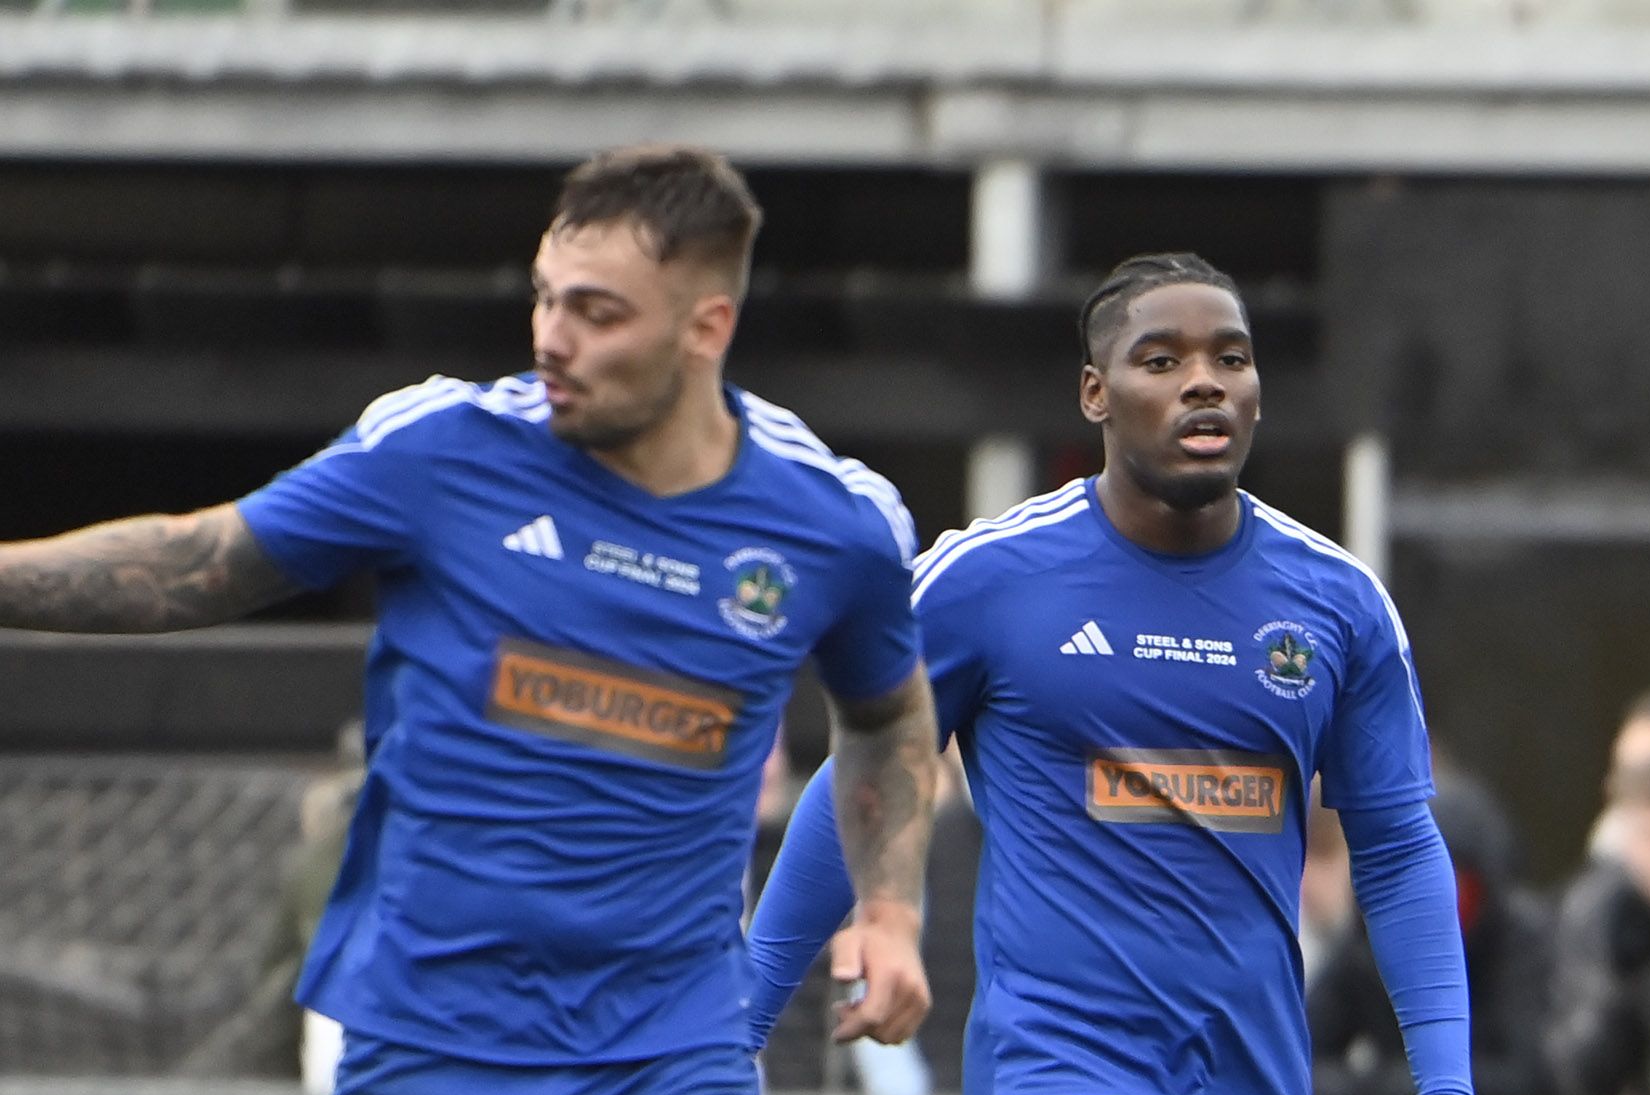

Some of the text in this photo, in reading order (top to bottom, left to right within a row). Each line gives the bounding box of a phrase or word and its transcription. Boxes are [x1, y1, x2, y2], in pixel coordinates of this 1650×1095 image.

[1136, 634, 1233, 652] STEEL & SONS
[1133, 647, 1237, 666] CUP FINAL 2024
[1101, 765, 1279, 817] YOBURGER
